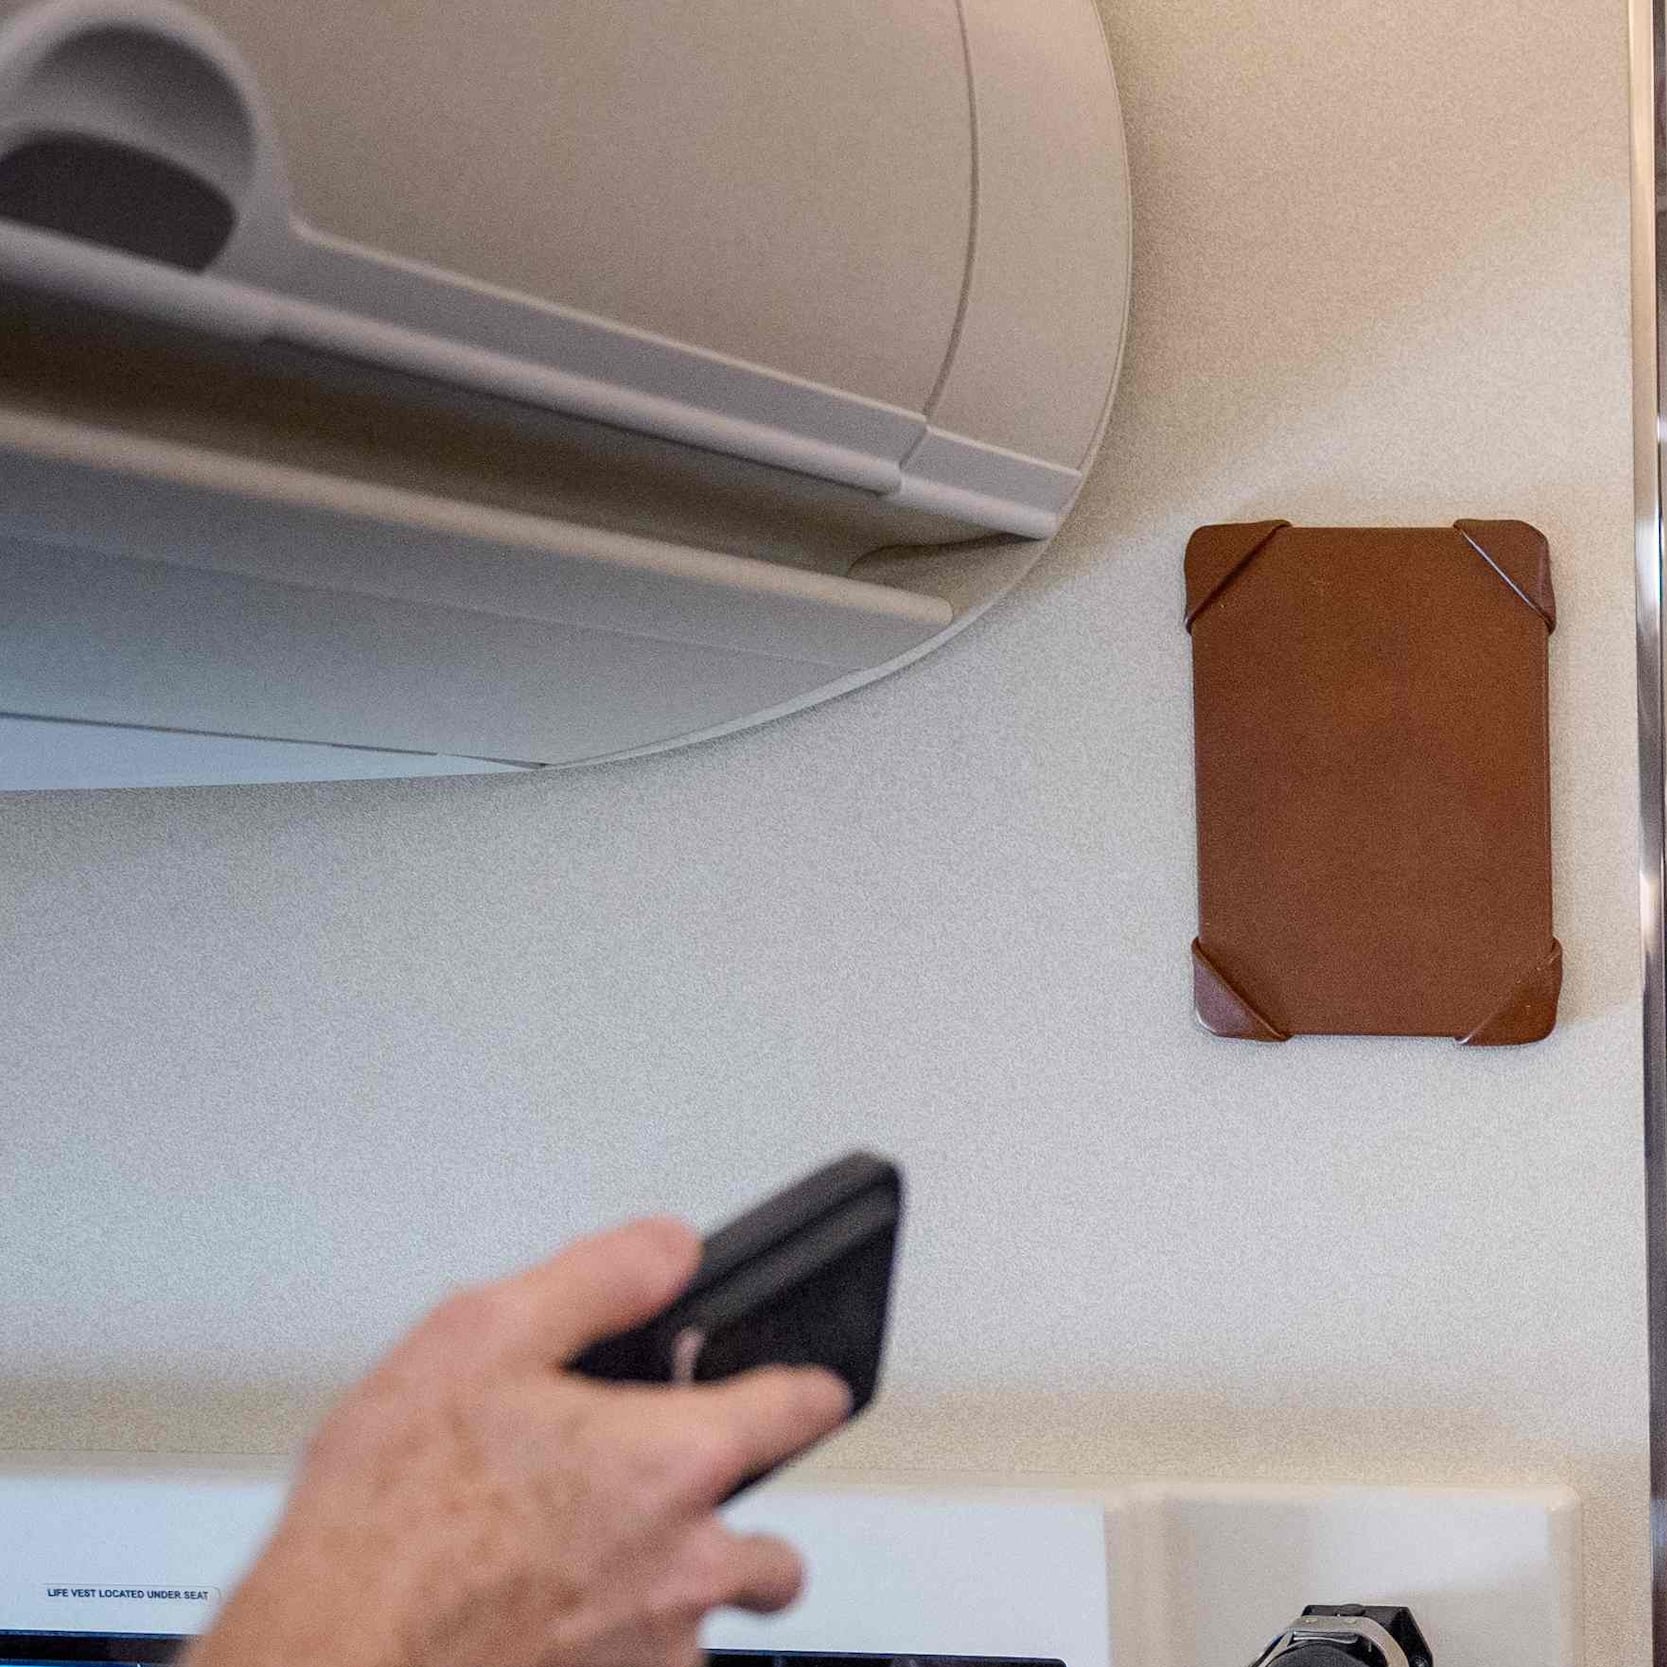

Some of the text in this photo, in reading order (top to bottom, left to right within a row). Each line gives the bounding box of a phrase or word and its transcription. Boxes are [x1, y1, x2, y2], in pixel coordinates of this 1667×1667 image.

[47, 1588, 208, 1600] LIFE VEST LOCATED UNDER SEAT
